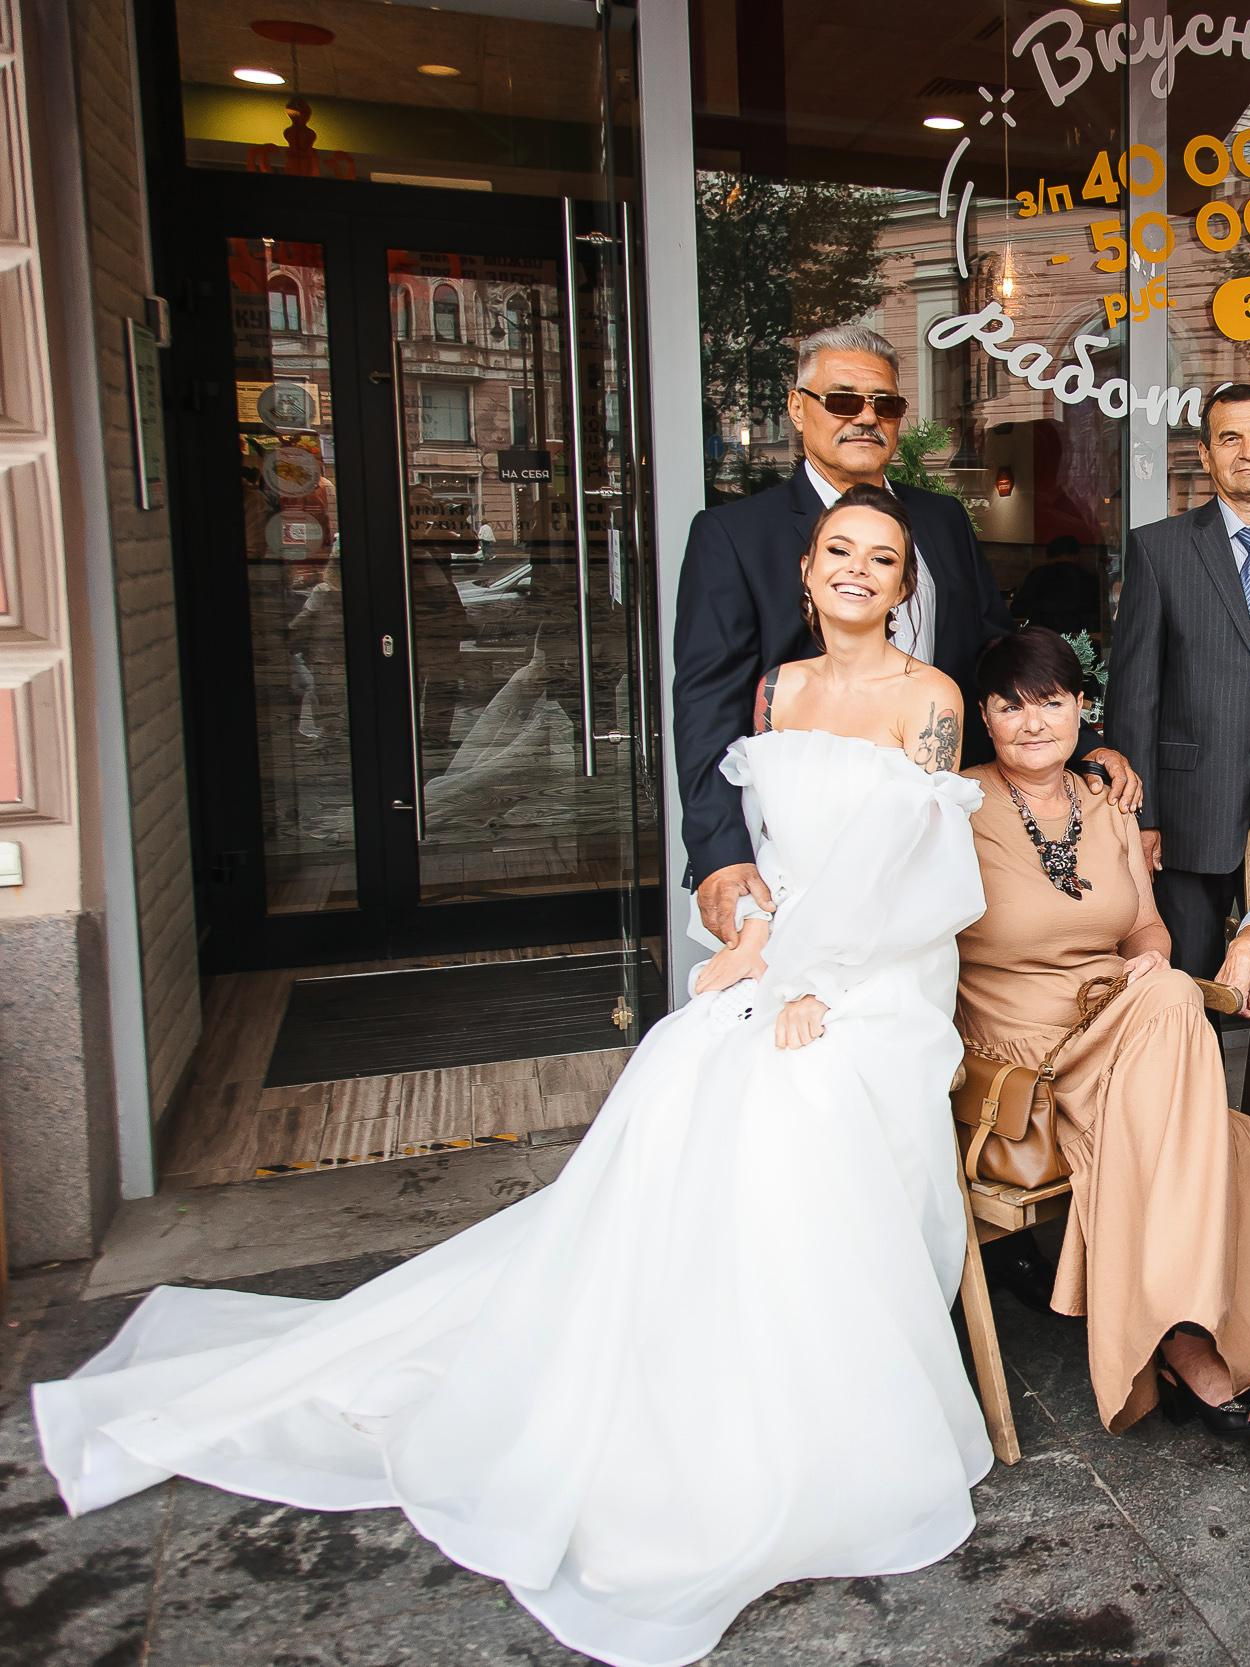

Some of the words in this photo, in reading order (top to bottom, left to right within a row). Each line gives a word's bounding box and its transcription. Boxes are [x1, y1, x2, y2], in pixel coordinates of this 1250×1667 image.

[1015, 178, 1074, 218] з/п
[1081, 143, 1166, 205] 40
[1051, 253, 1070, 265] -
[1090, 211, 1175, 273] 50
[1103, 275, 1177, 328] руб.
[502, 470, 518, 478] НА
[521, 470, 549, 479] СЕБЯ
